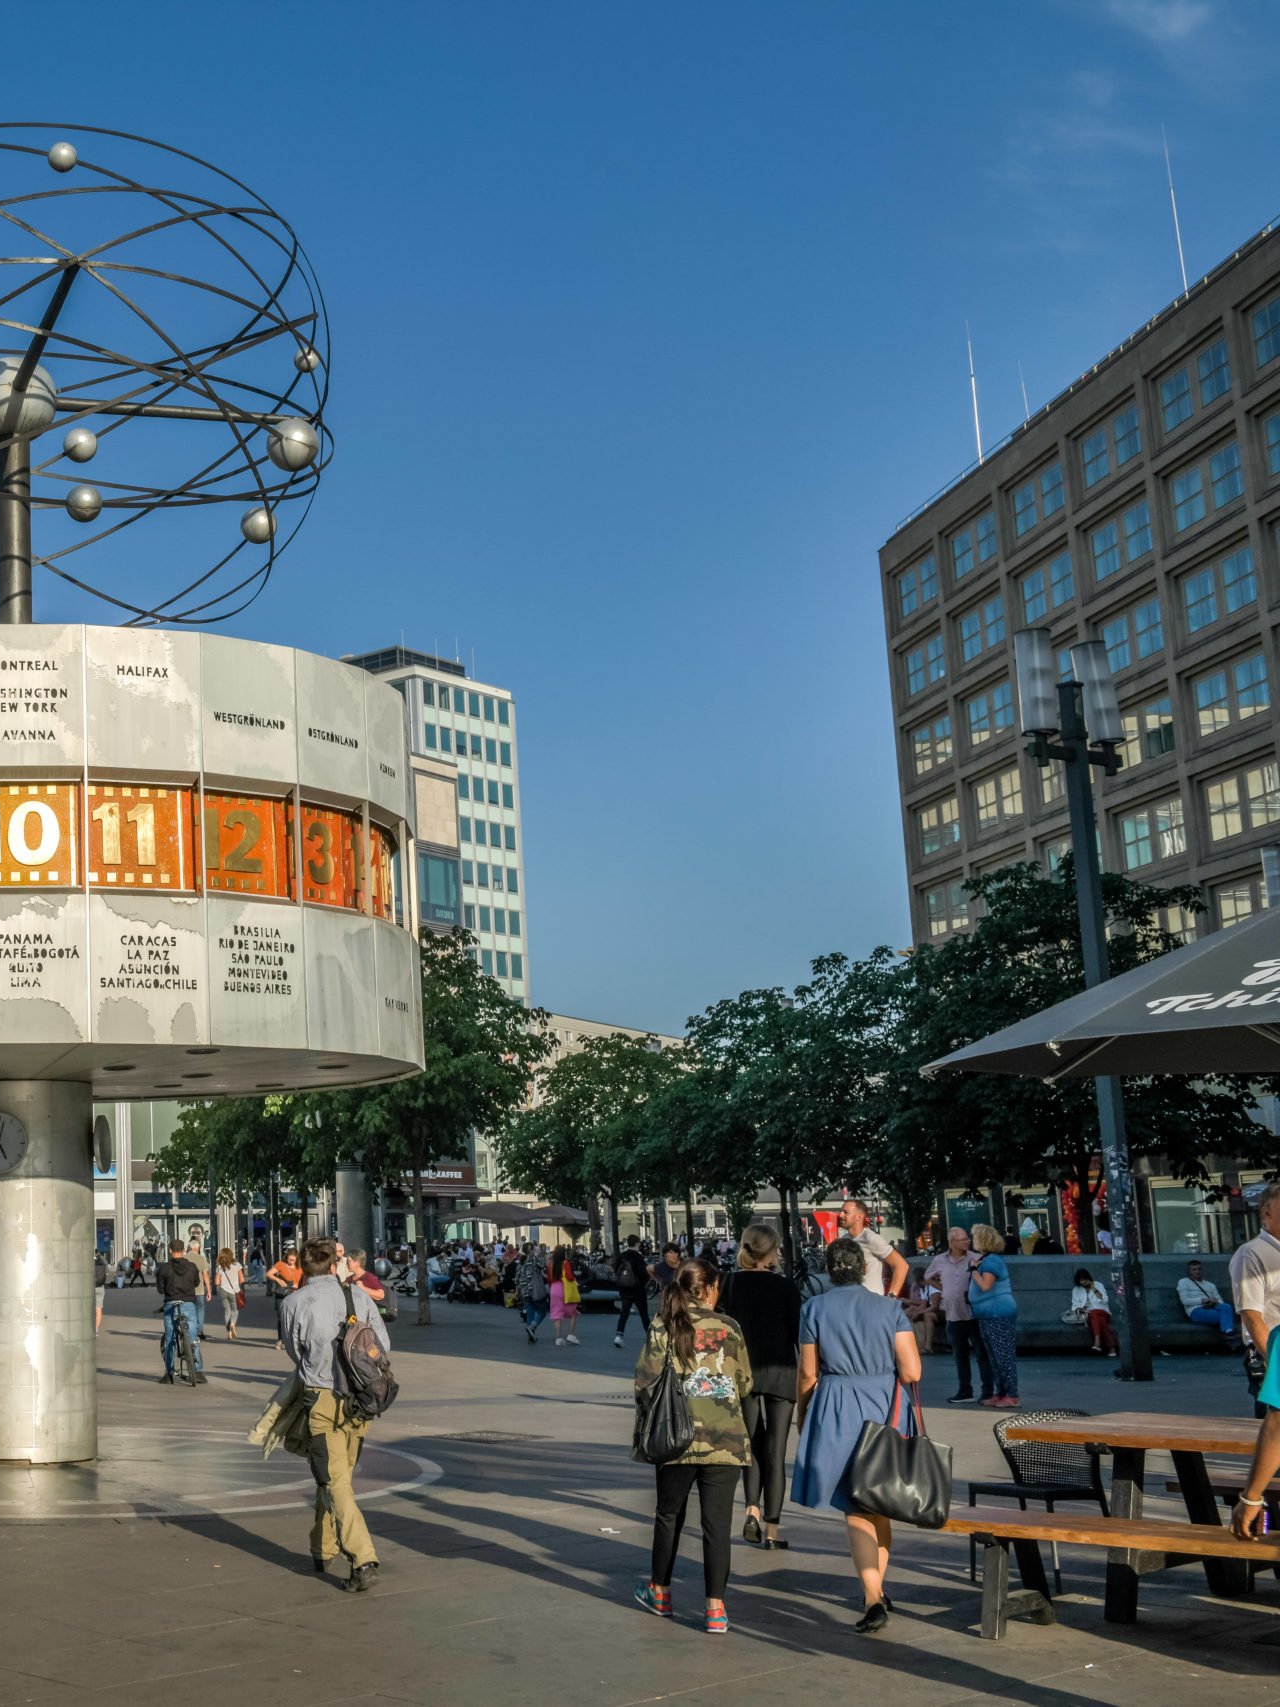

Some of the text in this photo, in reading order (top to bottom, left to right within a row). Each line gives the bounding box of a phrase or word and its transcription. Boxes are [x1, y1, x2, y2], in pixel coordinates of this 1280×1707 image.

[117, 665, 169, 679] HALIFAX
[24, 702, 58, 713] YORK
[213, 711, 285, 731] WESTGRÖNLAND
[308, 727, 359, 749] OSTGRÖNLAND
[92, 802, 156, 866] 11
[195, 807, 263, 873] 12
[233, 924, 281, 939] BRASILIA
[120, 934, 177, 947] CARACAS
[218, 937, 295, 954] RIO DE JANEIRO
[33, 944, 80, 959] BOGOTÁ
[127, 949, 170, 961] LA PAZ
[254, 953, 284, 967] PAULO
[118, 962, 180, 975] ASUNCIÓN
[228, 967, 288, 981] MONTEVIDEO
[10, 976, 41, 988] LIMA
[100, 977, 160, 989] SANTIAGO
[165, 978, 198, 990] CHILE
[224, 981, 292, 996] BUENOS AIRES
